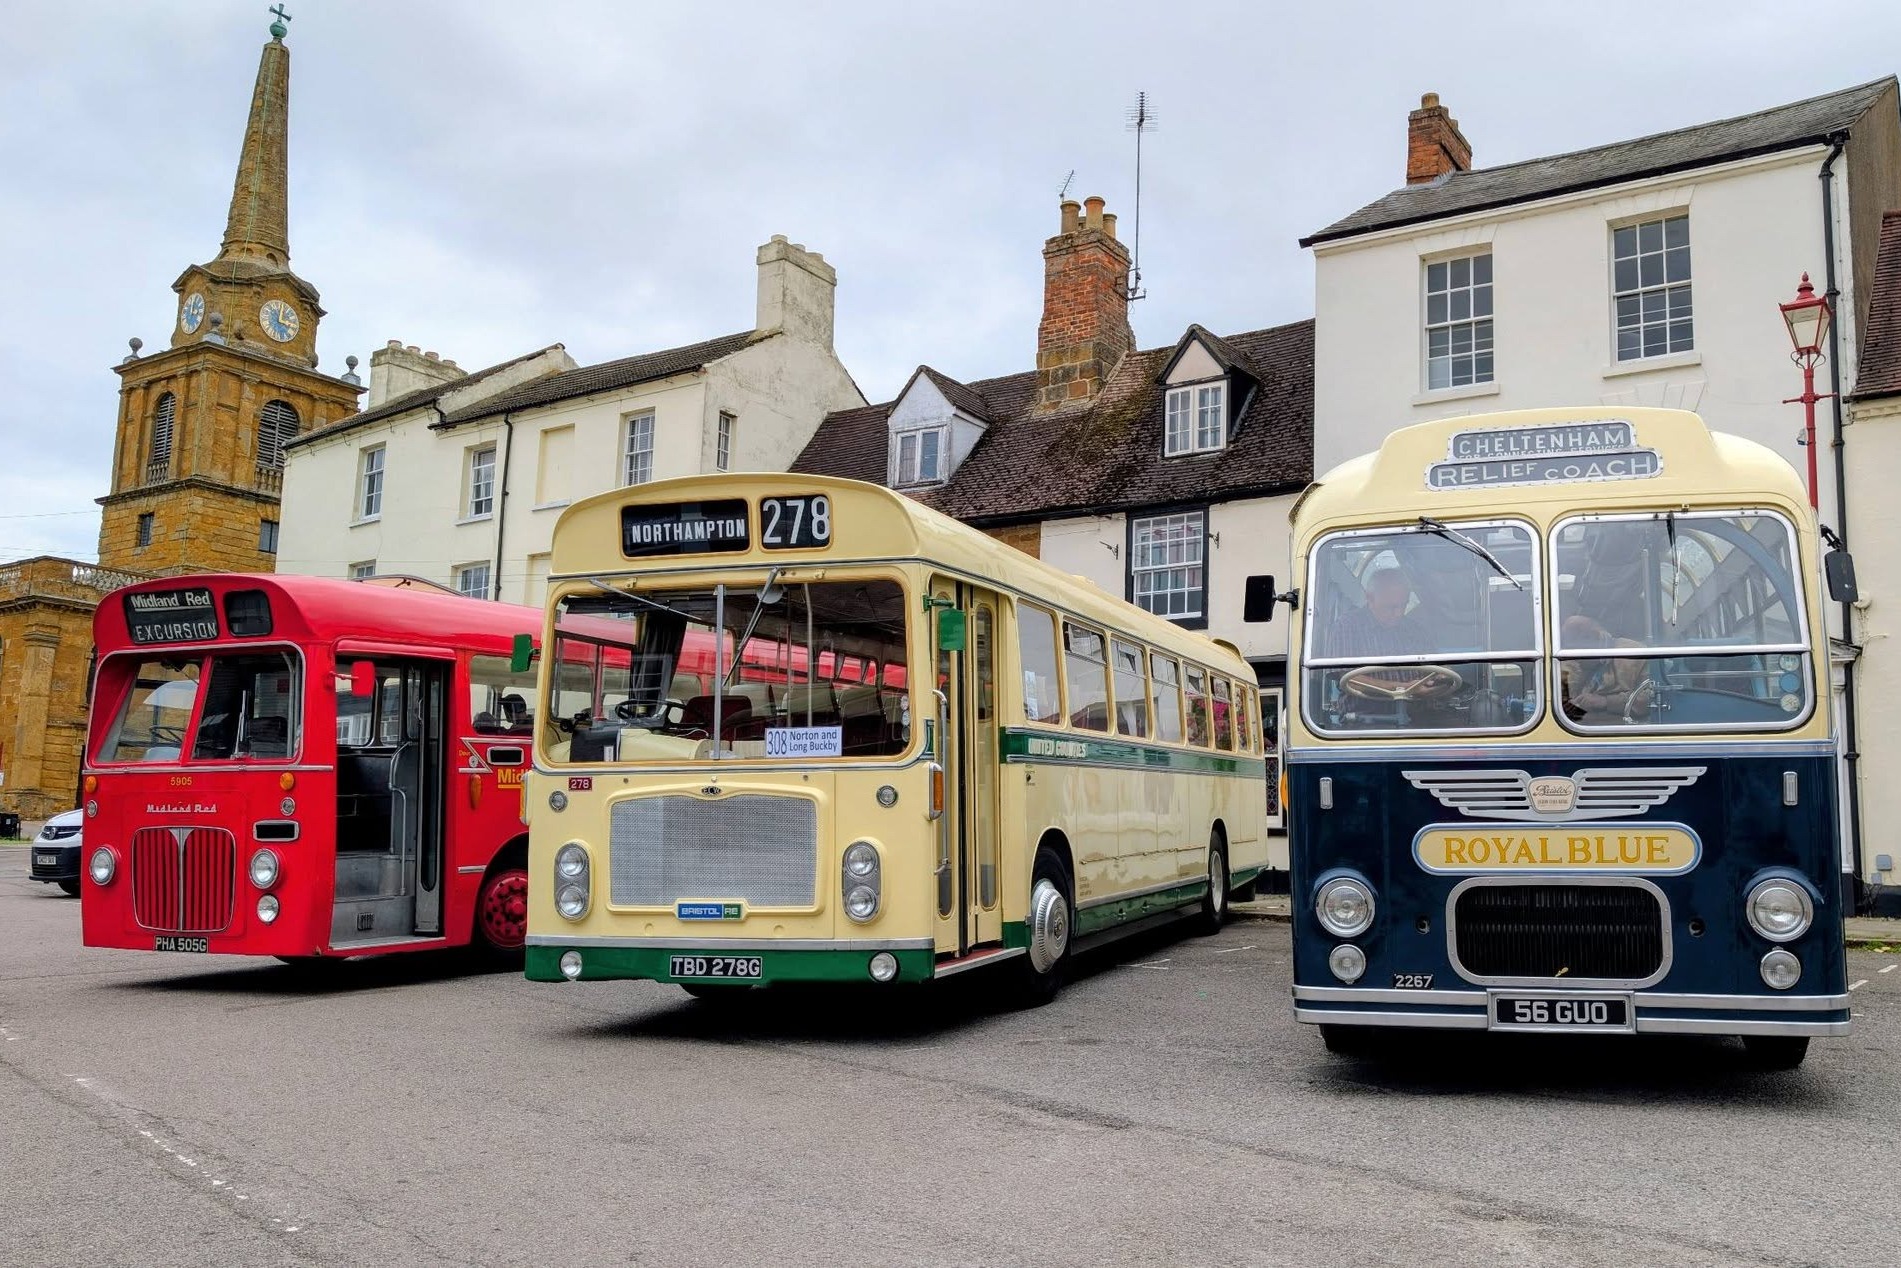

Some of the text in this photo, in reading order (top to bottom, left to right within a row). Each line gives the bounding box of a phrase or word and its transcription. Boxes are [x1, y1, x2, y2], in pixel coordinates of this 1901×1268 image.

[1459, 429, 1625, 455] CHELTENHAM
[1437, 455, 1651, 487] RELIEF COACH
[762, 496, 831, 545] 278
[631, 518, 746, 544] NORTHAMPTON
[130, 591, 211, 609] Midland Red
[135, 622, 218, 641] EXCURSION
[767, 730, 788, 755] 308
[789, 729, 837, 741] Norton and
[789, 740, 838, 753] Long Buckby
[170, 776, 193, 786] 5905
[497, 768, 529, 784] Mid
[571, 779, 590, 790] 278
[146, 804, 217, 813] Midland Red
[1444, 836, 1671, 864] ROYAL BLUE
[681, 907, 739, 915] BRISTOL RE
[155, 936, 207, 952] PHA 505G
[672, 957, 760, 977] TBD 278G
[1395, 974, 1433, 989] 2267
[1514, 1000, 1608, 1025] 56 GUO
